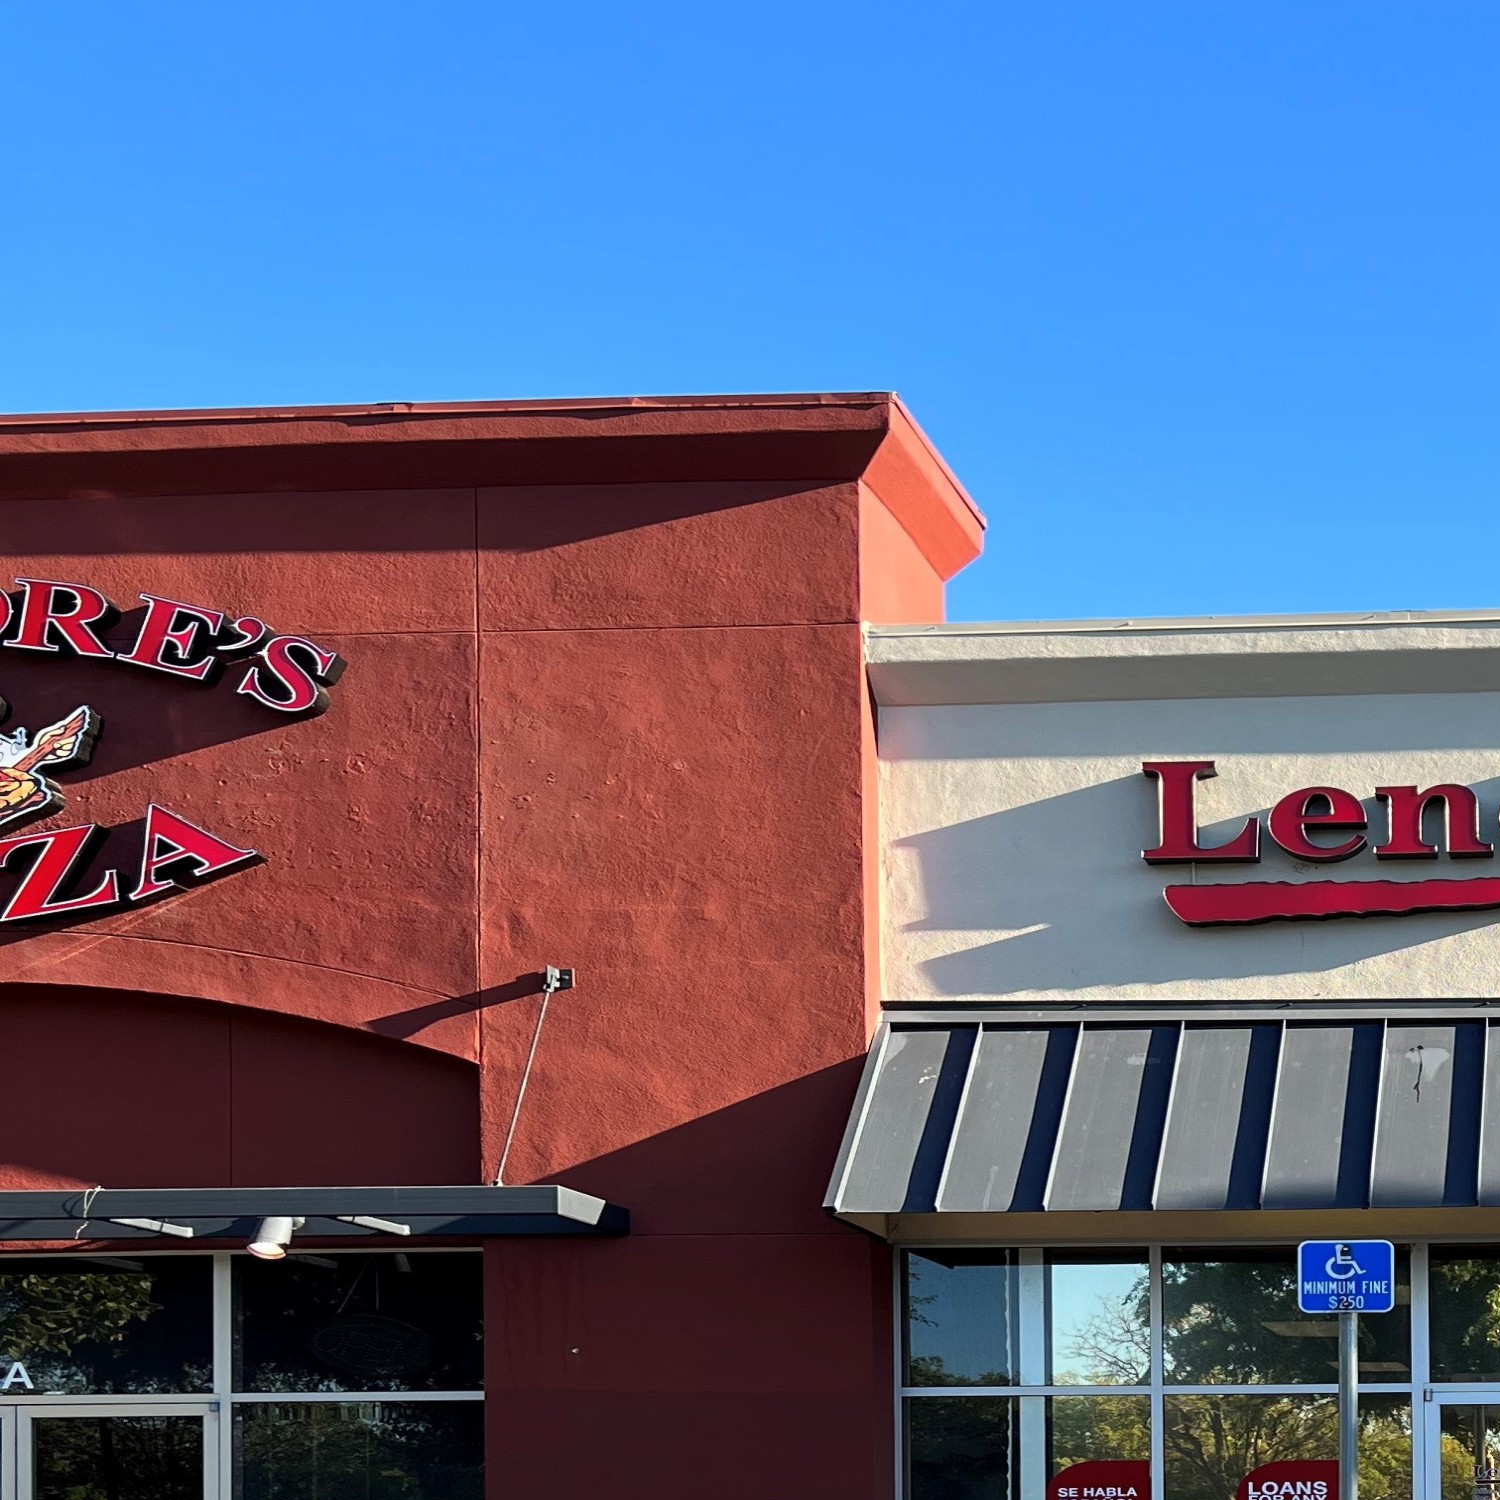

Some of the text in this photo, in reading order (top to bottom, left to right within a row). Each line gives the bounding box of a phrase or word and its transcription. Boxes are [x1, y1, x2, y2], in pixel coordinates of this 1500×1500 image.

[0, 577, 338, 712] RE'S
[1303, 1280, 1389, 1295] MINIMUM FINE
[1328, 1295, 1365, 1309] $250
[2, 1361, 34, 1389] A
[1057, 1486, 1137, 1497] SE HABLA
[1248, 1481, 1328, 1495] LOANS
